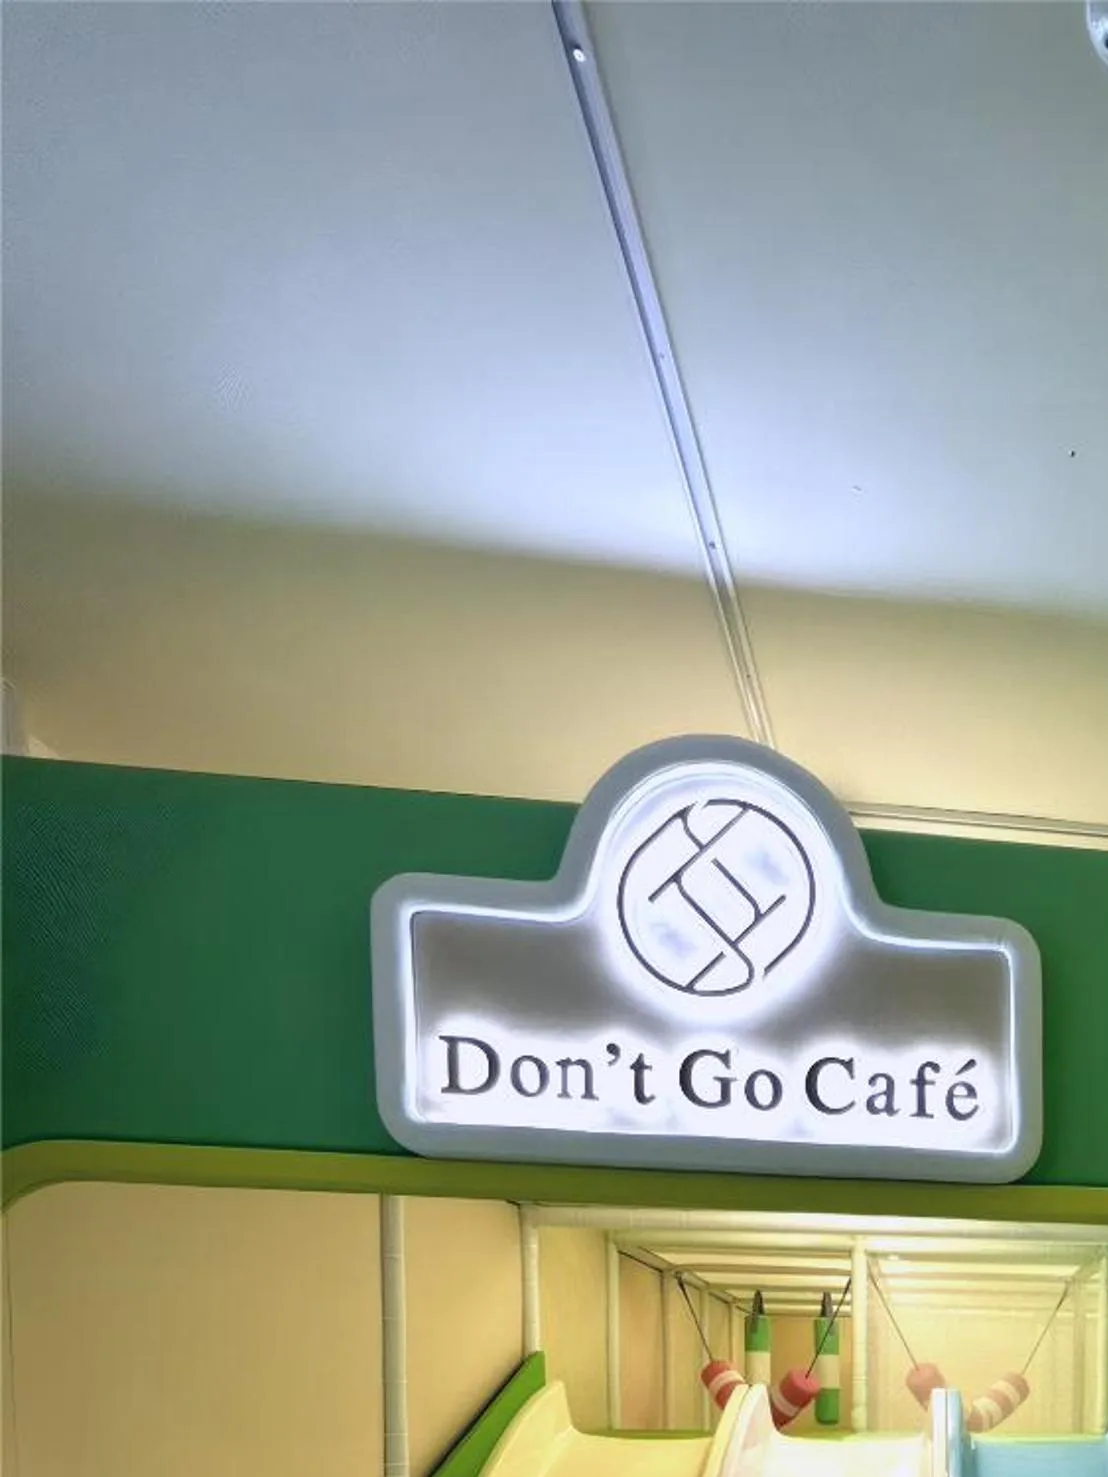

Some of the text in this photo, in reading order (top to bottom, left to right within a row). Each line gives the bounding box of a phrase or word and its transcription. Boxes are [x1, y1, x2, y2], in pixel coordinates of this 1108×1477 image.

[438, 1034, 980, 1121] Don't Go Café
